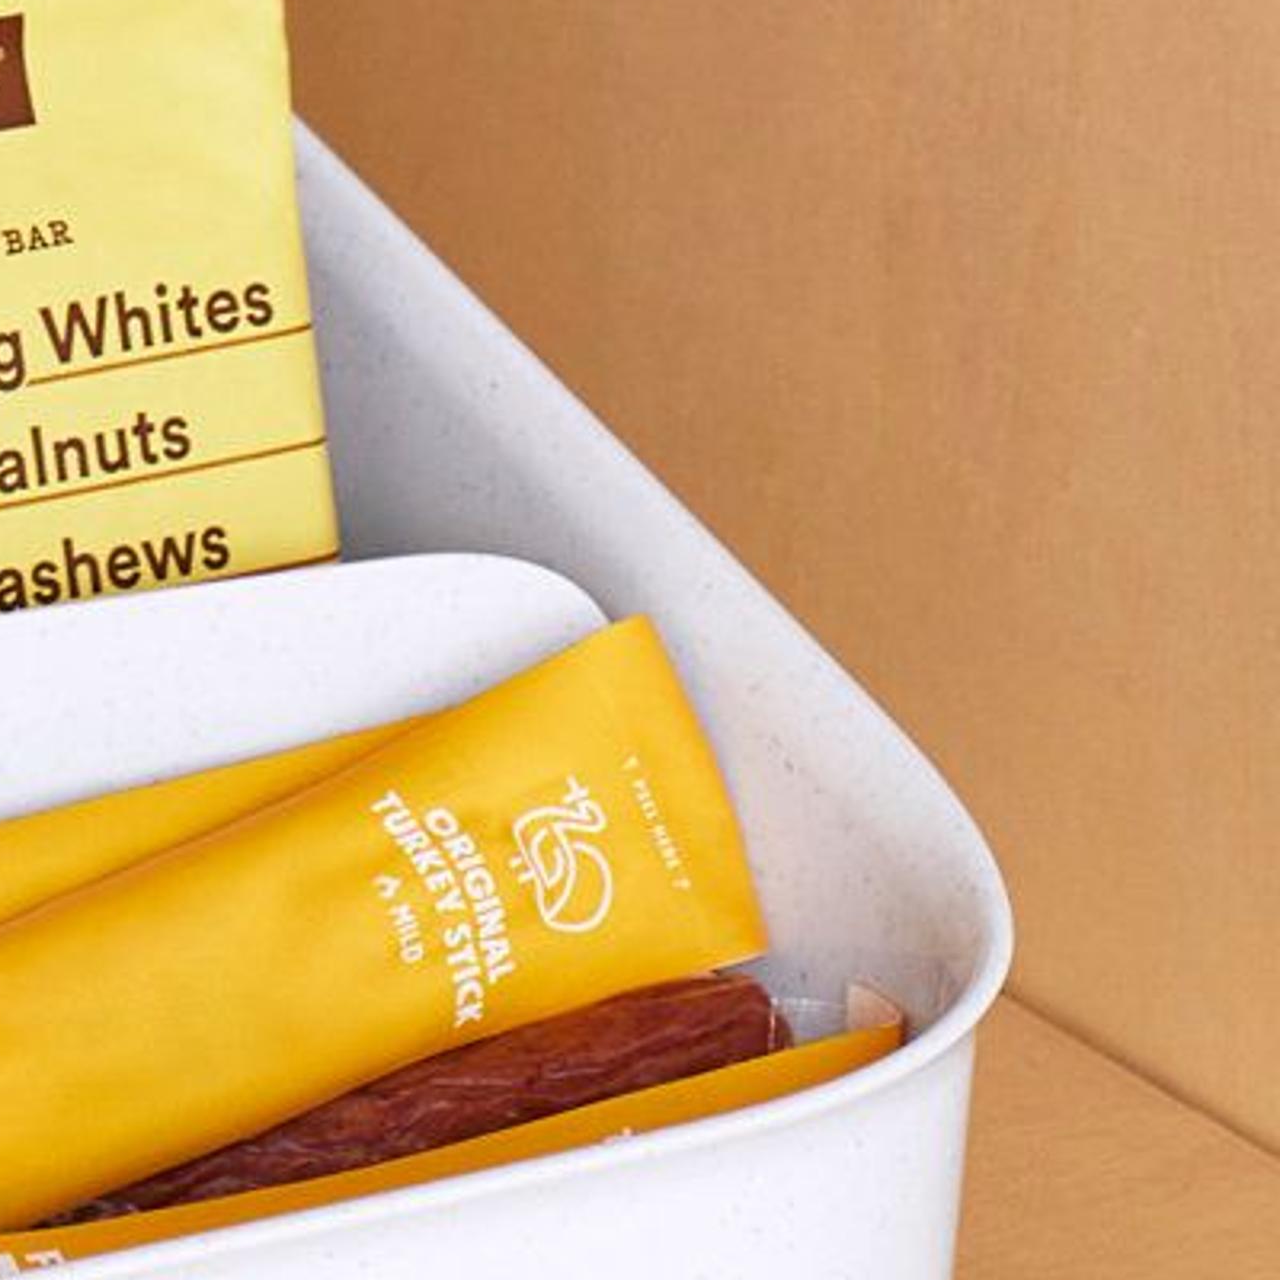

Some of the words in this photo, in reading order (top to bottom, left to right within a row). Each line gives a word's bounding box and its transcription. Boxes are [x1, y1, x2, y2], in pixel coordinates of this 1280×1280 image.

[4, 219, 76, 256] BAR
[40, 280, 275, 365] Whites
[369, 789, 465, 915] TURKEY
[441, 918, 486, 1029] STICK
[388, 902, 425, 966] MILD
[422, 806, 517, 985] ORIGINAL
